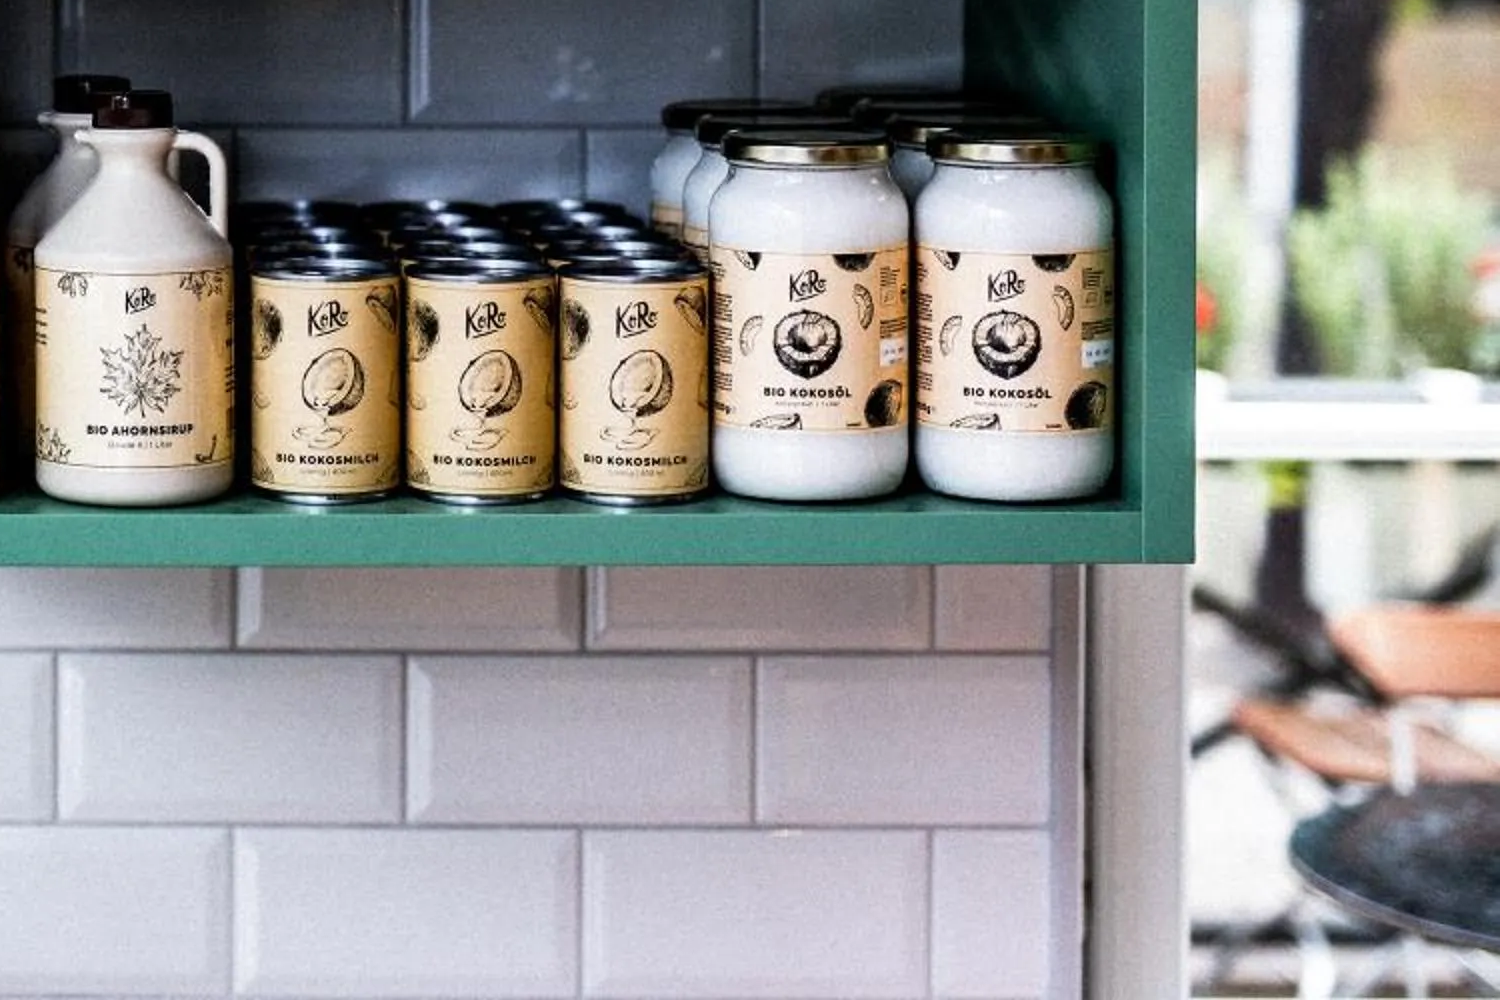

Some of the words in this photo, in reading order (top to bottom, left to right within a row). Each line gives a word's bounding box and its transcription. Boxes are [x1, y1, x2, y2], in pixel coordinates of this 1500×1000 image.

[789, 269, 828, 303] KoRo
[987, 269, 1026, 303] KoRo
[307, 299, 350, 338] KoRo
[465, 300, 508, 340] KoRo
[615, 300, 659, 339] KoRo
[763, 386, 786, 398] BIO
[789, 385, 853, 399] KOKOSÖL
[963, 386, 986, 398] BIO
[989, 385, 1053, 399] KOKOSÖL
[86, 424, 109, 436] BIO
[111, 423, 194, 437] AHORNSIRUP
[275, 453, 296, 463] BIO
[299, 452, 379, 466] KOKOSMILCH
[433, 455, 453, 465] BIO
[455, 454, 537, 467] KOKOSMILCH
[583, 453, 603, 465] BIO
[607, 454, 688, 467] KOKOSMILCH
